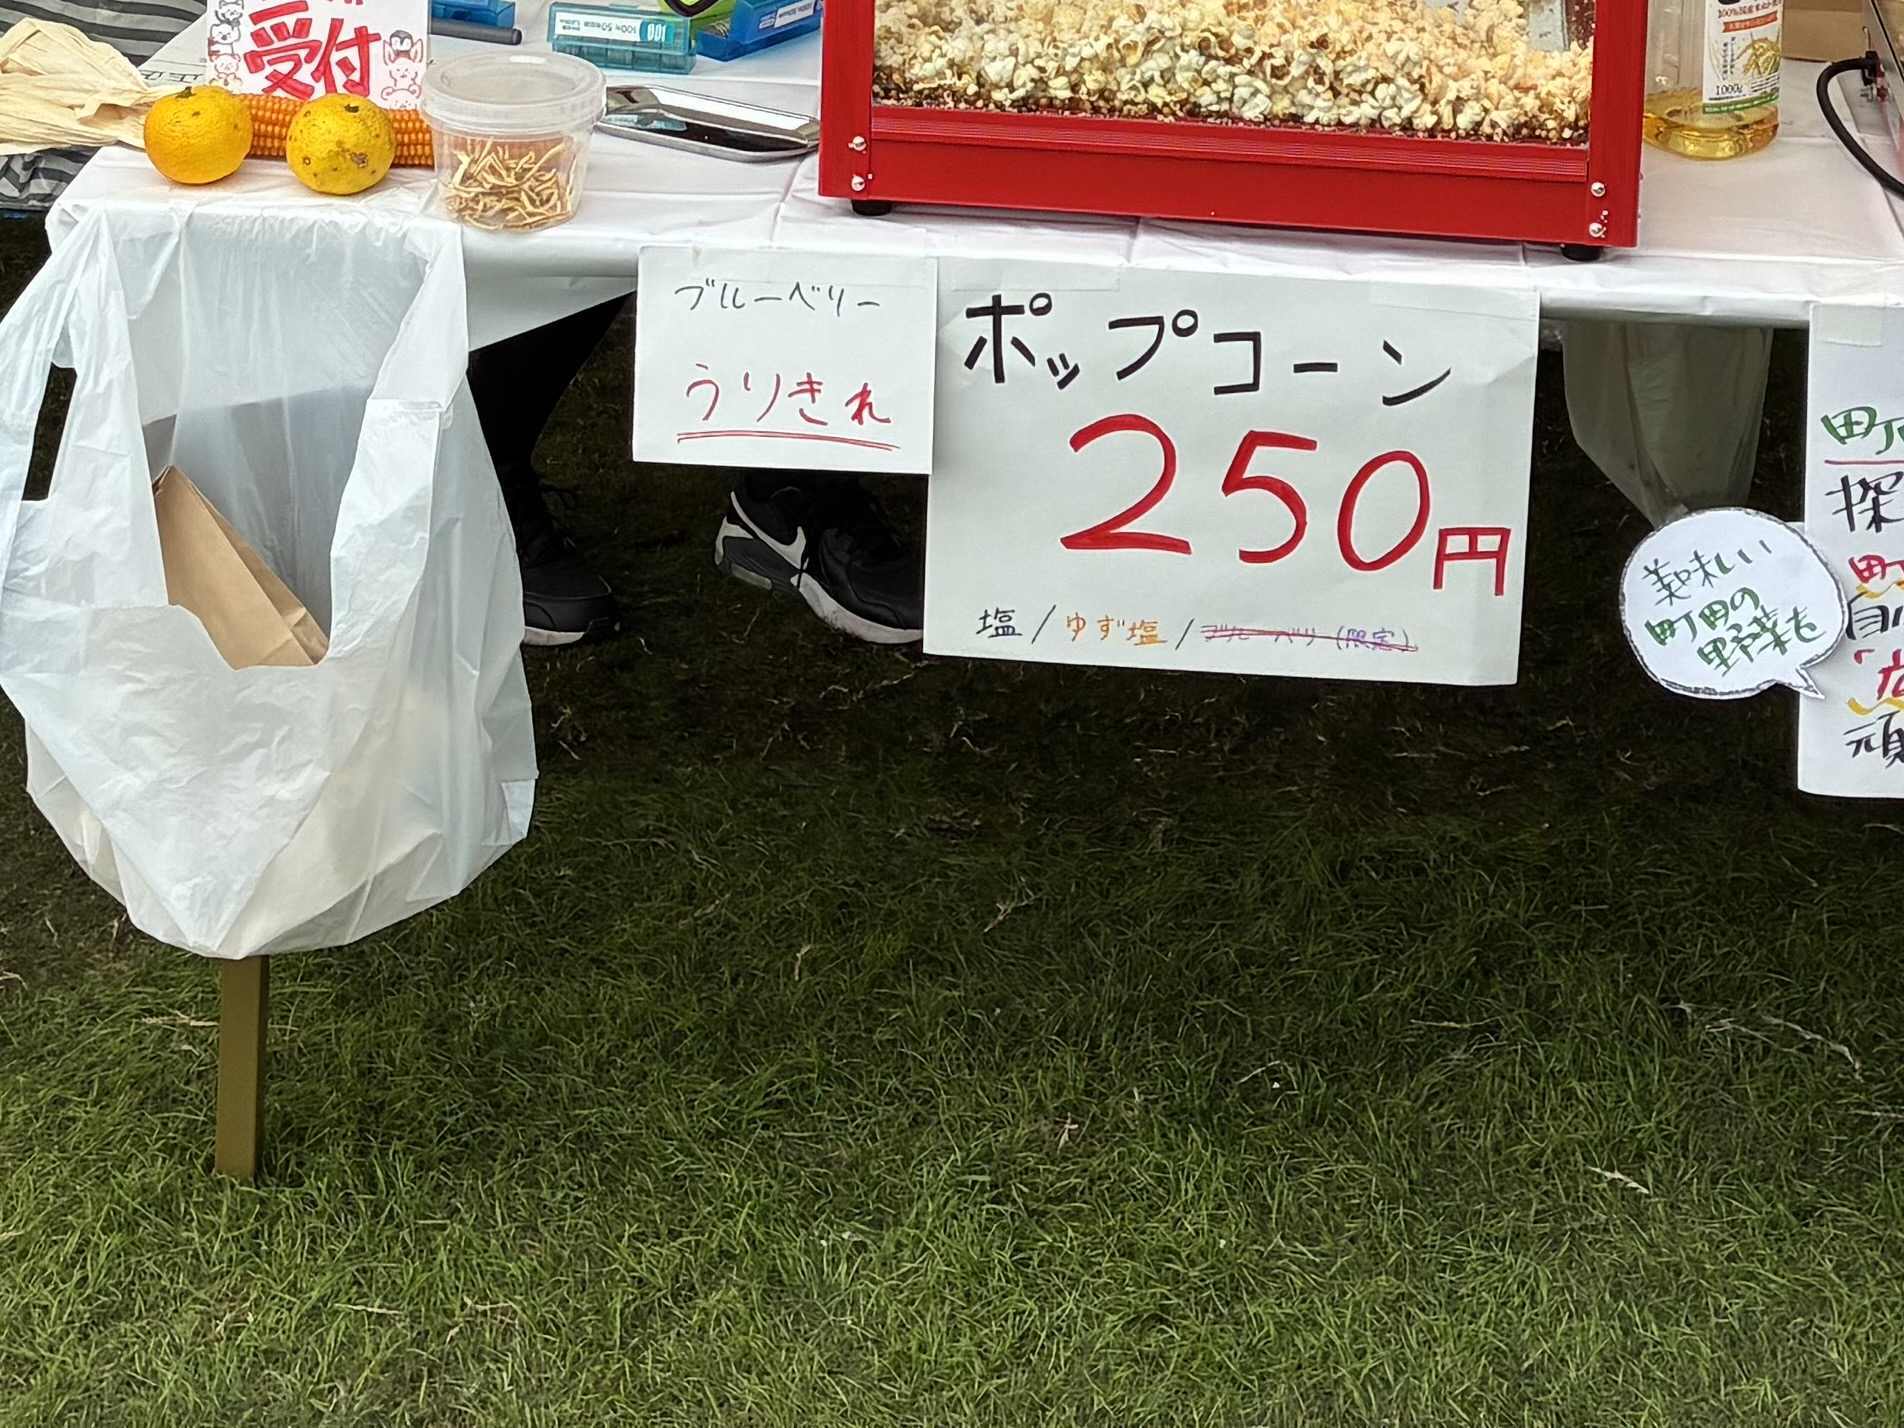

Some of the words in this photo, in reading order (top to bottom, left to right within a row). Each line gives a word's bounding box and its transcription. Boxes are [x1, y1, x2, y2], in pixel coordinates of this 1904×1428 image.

[243, 0, 382, 101] 受付
[674, 278, 881, 319] ブルーベリー
[963, 290, 1452, 408] ポップコーン
[683, 362, 892, 428] うりきれ
[1059, 412, 1513, 597] 250円
[1644, 587, 1761, 646] 町田の
